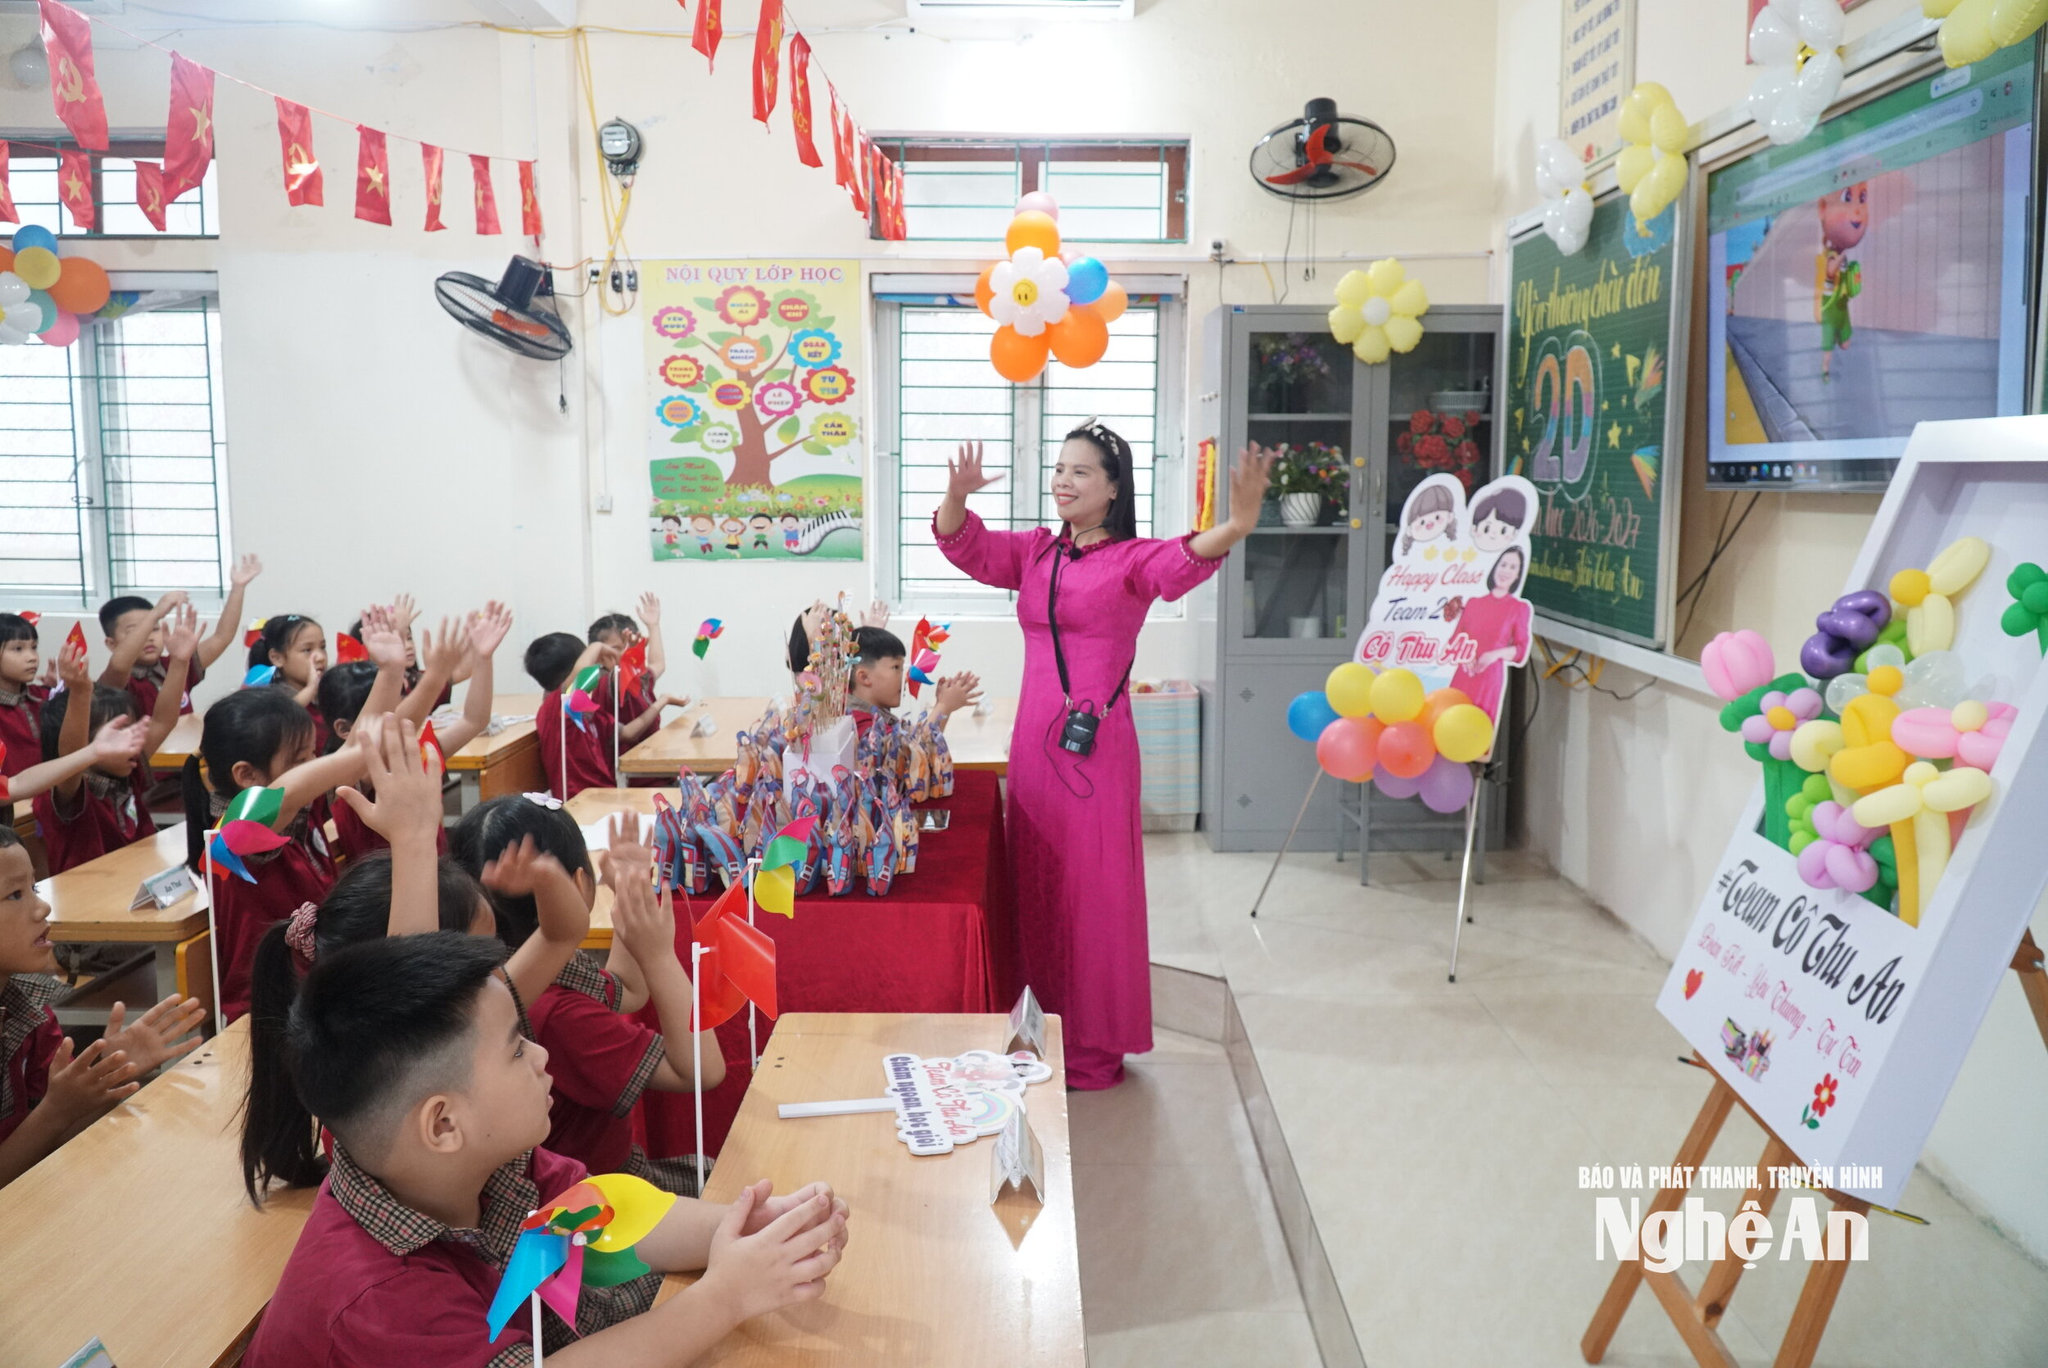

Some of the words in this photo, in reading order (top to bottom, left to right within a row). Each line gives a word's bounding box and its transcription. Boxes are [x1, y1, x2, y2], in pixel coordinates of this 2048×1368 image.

[666, 263, 699, 283] NỘI
[708, 266, 748, 283] QUY
[755, 263, 793, 281] LỚP
[800, 266, 842, 284] HỌC
[1387, 564, 1439, 592] Happy
[1441, 562, 1484, 586] Class
[1383, 596, 1428, 622] Team
[1361, 633, 1392, 661] Cô
[1399, 634, 1437, 662] Thu
[1439, 635, 1476, 662] An
[1717, 859, 1781, 934] #Team
[1772, 894, 1818, 955] Cô
[1801, 913, 1859, 990] Thu
[1847, 955, 1905, 1025] An
[922, 1061, 953, 1086] Team
[903, 1111, 932, 1129] học
[936, 1099, 972, 1118] Thu
[906, 1129, 944, 1148] giỏi
[943, 1120, 977, 1137] An
